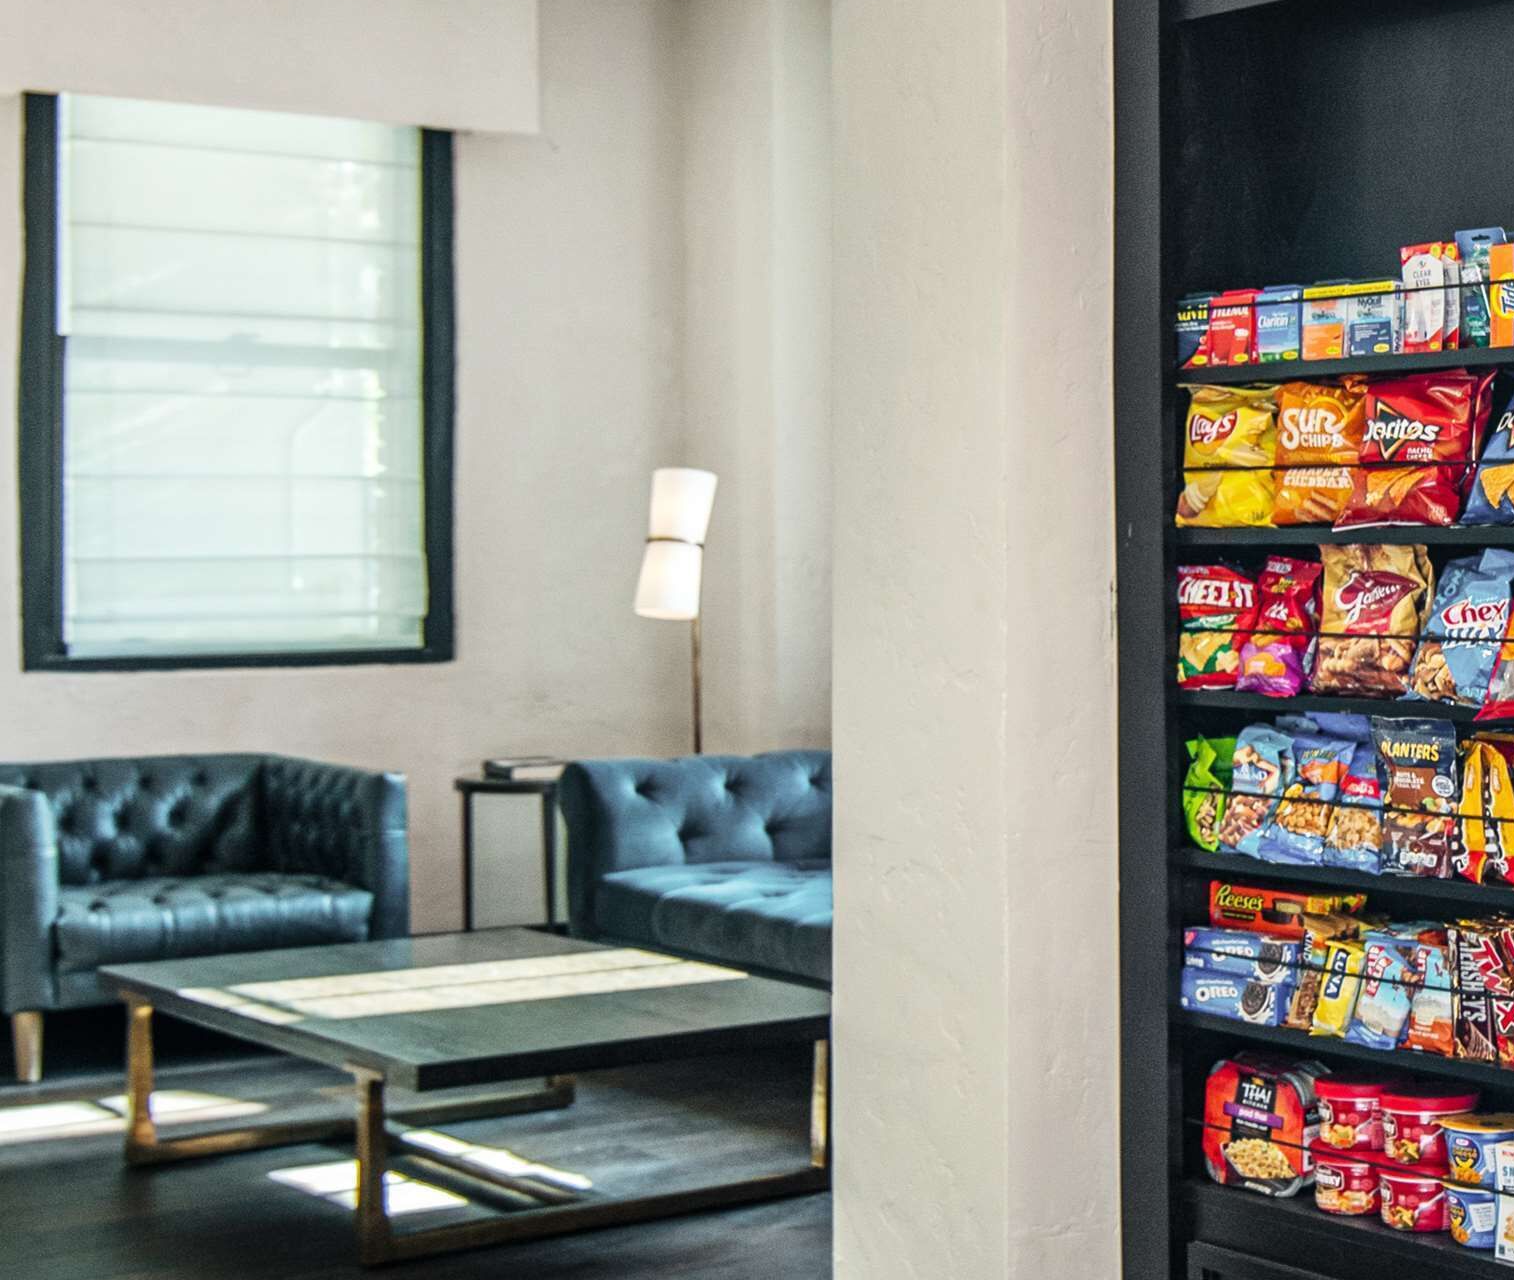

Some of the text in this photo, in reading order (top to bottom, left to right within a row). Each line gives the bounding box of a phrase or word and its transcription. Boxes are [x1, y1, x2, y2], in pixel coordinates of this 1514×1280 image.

[1413, 270, 1431, 279] CLEAR
[1442, 598, 1509, 626] Chex
[1214, 884, 1265, 912] Reese's
[1303, 930, 1313, 961] KIND
[1195, 985, 1239, 1002] OREO
[1241, 1082, 1272, 1104] THAI
